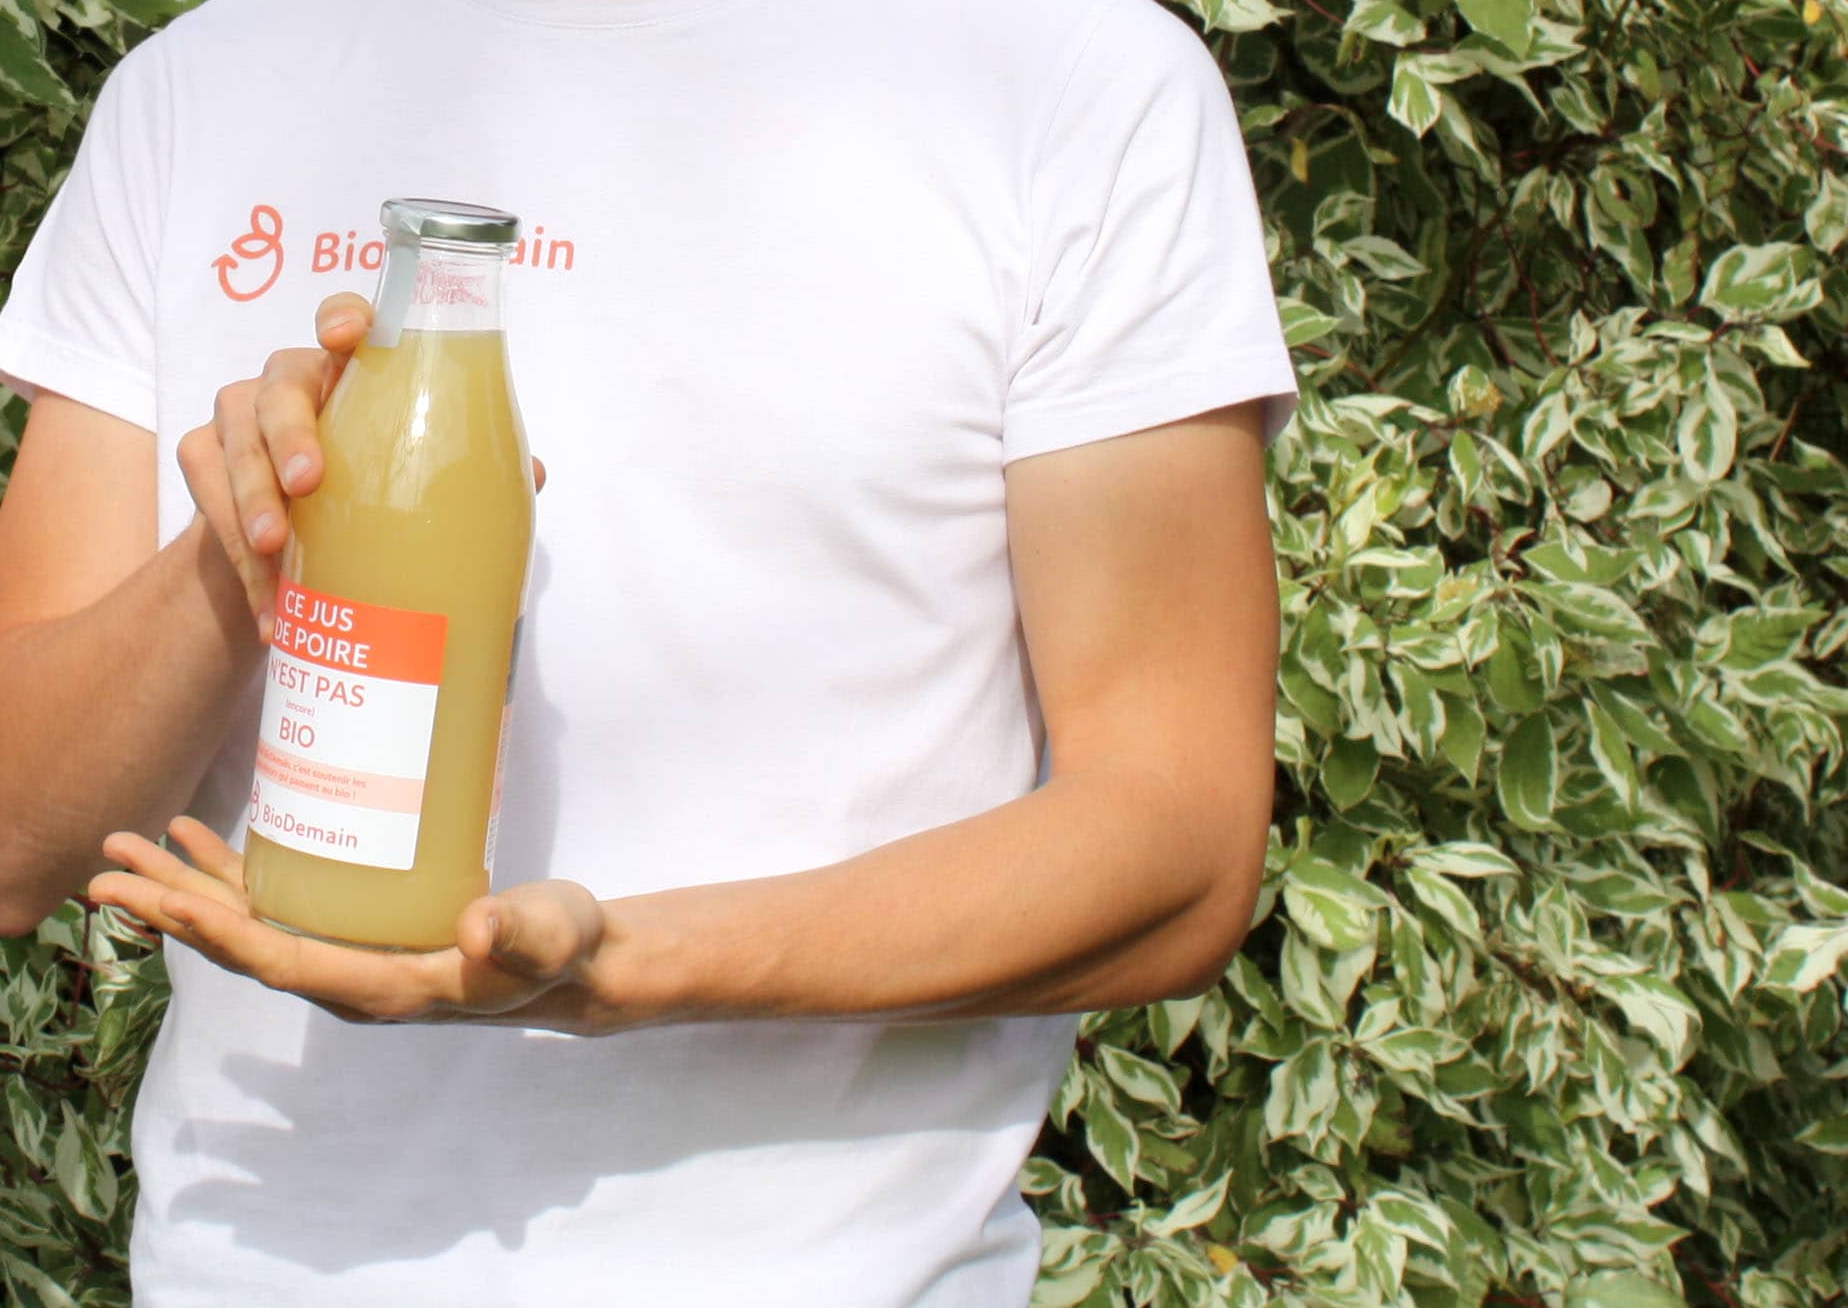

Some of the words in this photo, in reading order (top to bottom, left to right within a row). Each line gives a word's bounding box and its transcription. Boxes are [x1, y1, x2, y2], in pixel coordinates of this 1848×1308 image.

[312, 226, 574, 274] Bioain
[285, 590, 306, 619] CE
[308, 600, 354, 632] JUS
[274, 616, 292, 646] DE
[294, 627, 371, 669] POIRE
[270, 656, 311, 694] N'EST
[314, 675, 367, 708] PAS
[279, 716, 315, 748] BIO
[263, 803, 358, 849] BioDemain
